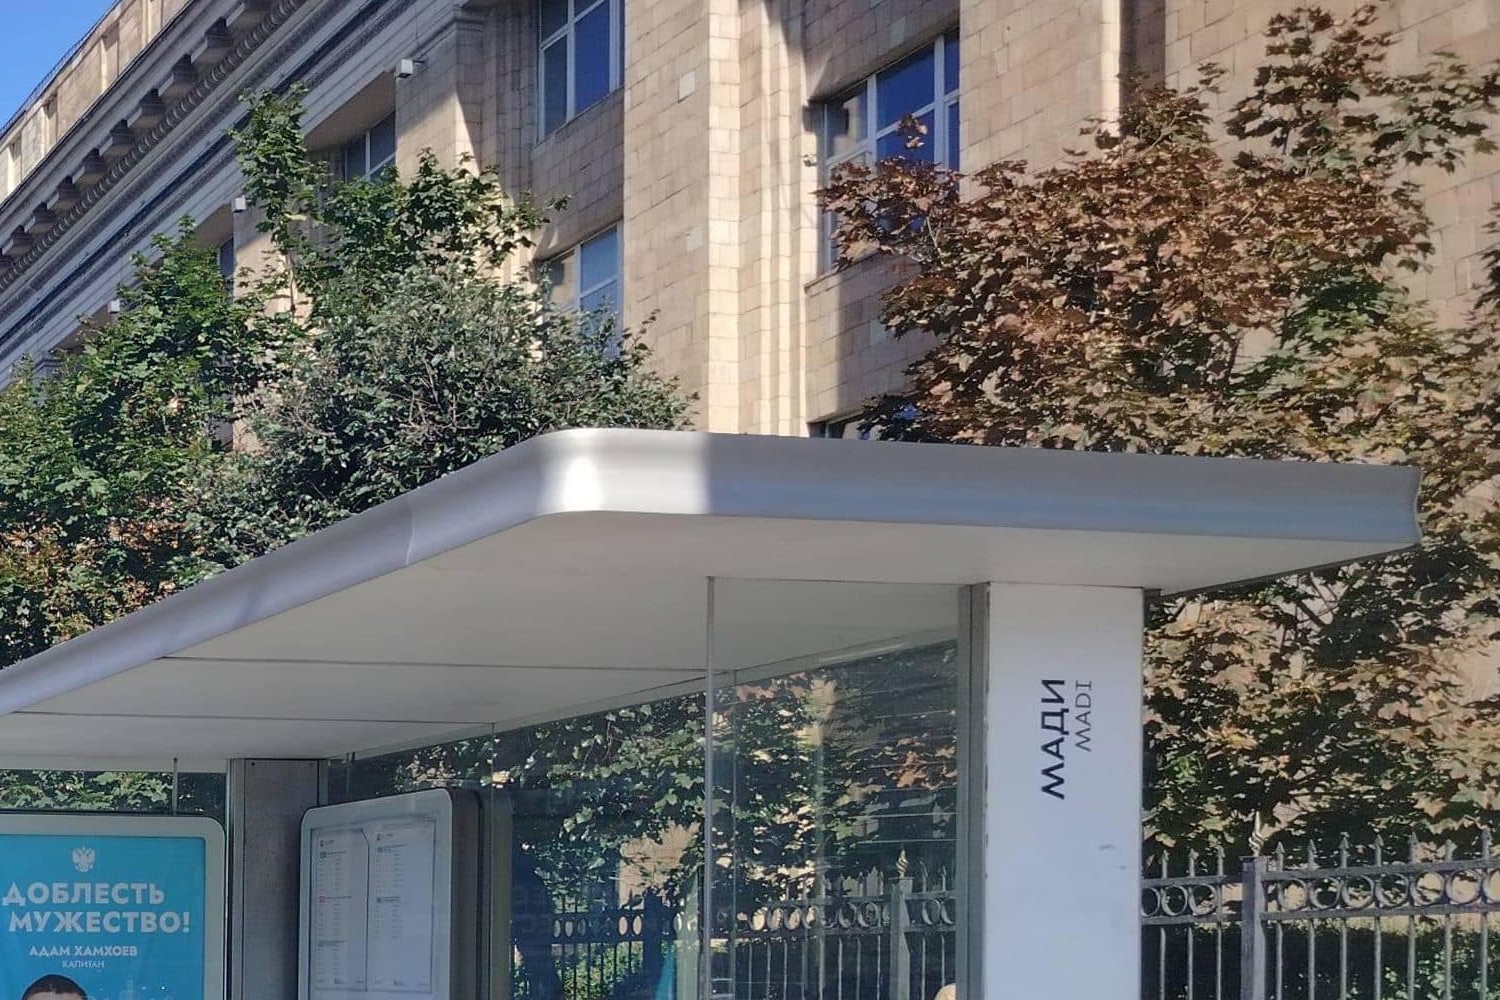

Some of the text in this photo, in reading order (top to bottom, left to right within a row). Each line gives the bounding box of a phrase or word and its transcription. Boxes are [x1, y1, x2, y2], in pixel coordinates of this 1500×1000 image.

[1075, 680, 1092, 752] MADI
[1041, 679, 1069, 800] МАДИ
[2, 882, 165, 906] ДОБЛЕСТЬ
[8, 911, 190, 933] МУЖЕСТВО!
[29, 945, 137, 957] АДАМ ХАМХОЕВ
[62, 959, 105, 969] КАПИТАН
